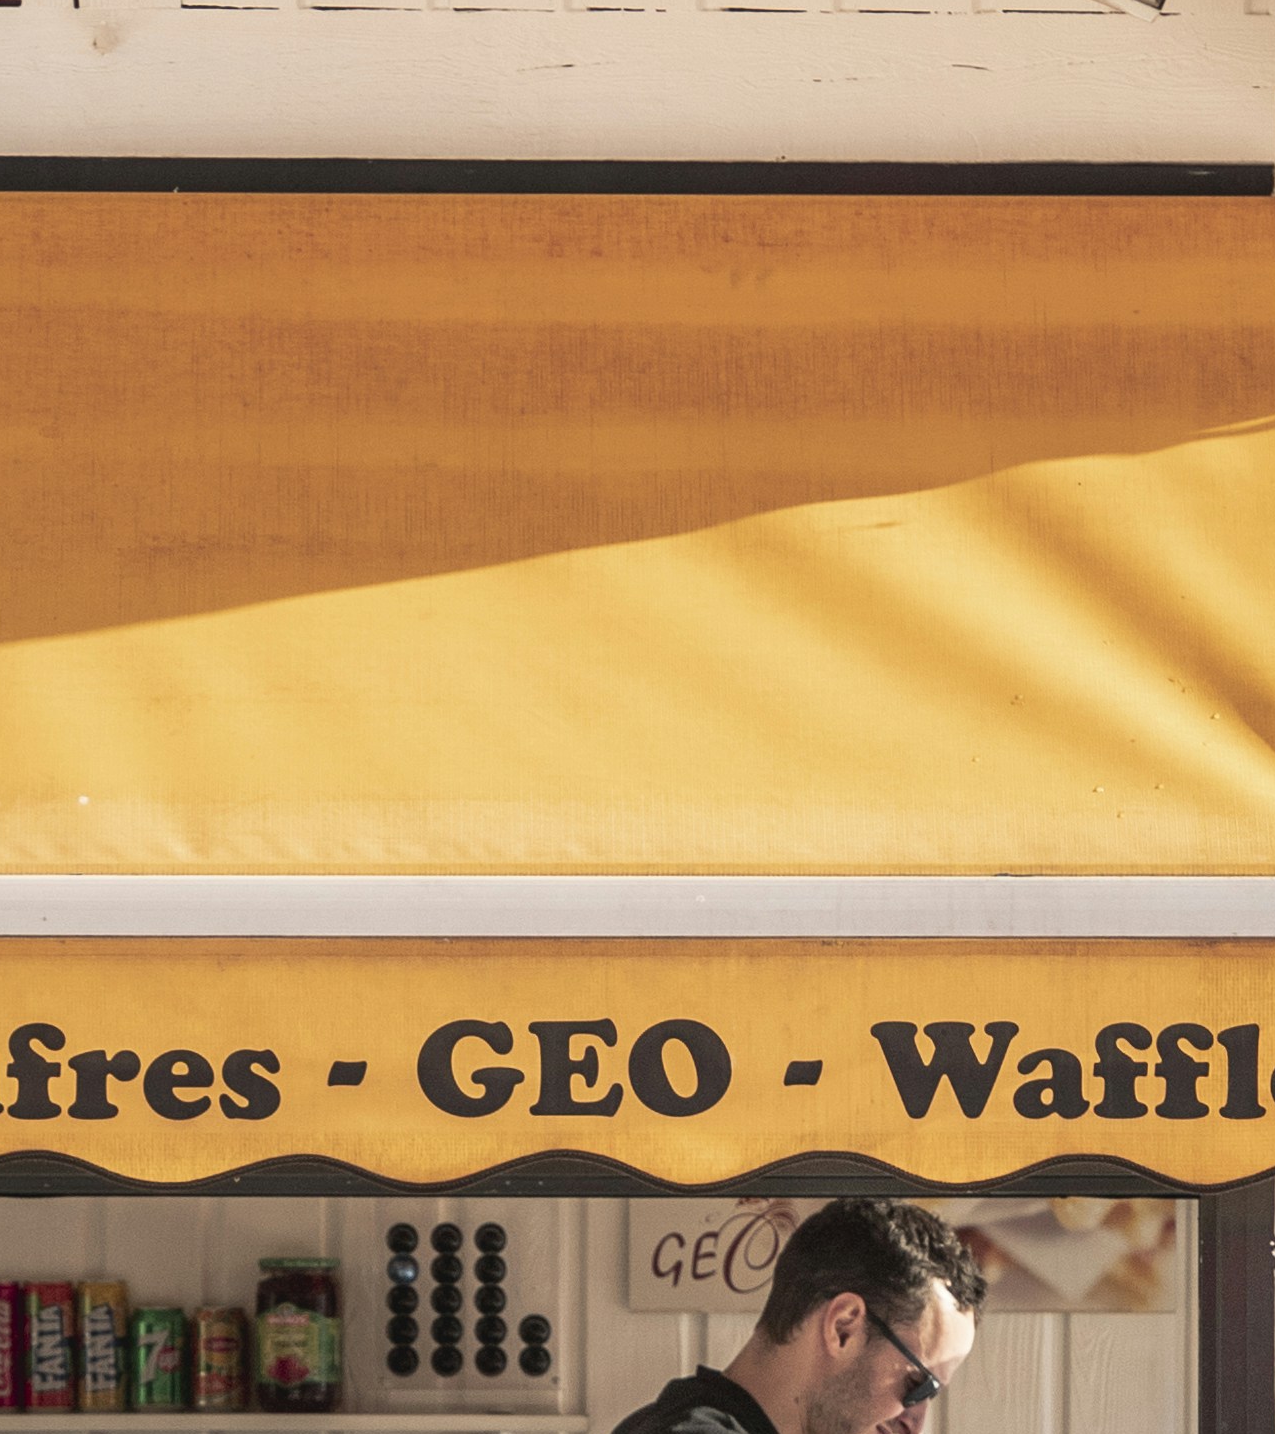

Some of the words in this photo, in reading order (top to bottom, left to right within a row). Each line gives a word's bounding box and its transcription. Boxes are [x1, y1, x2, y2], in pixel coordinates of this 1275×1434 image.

[327, 1061, 367, 1086] -
[417, 1018, 732, 1118] GEO
[784, 1060, 823, 1086] -
[651, 1205, 798, 1294] GEO
